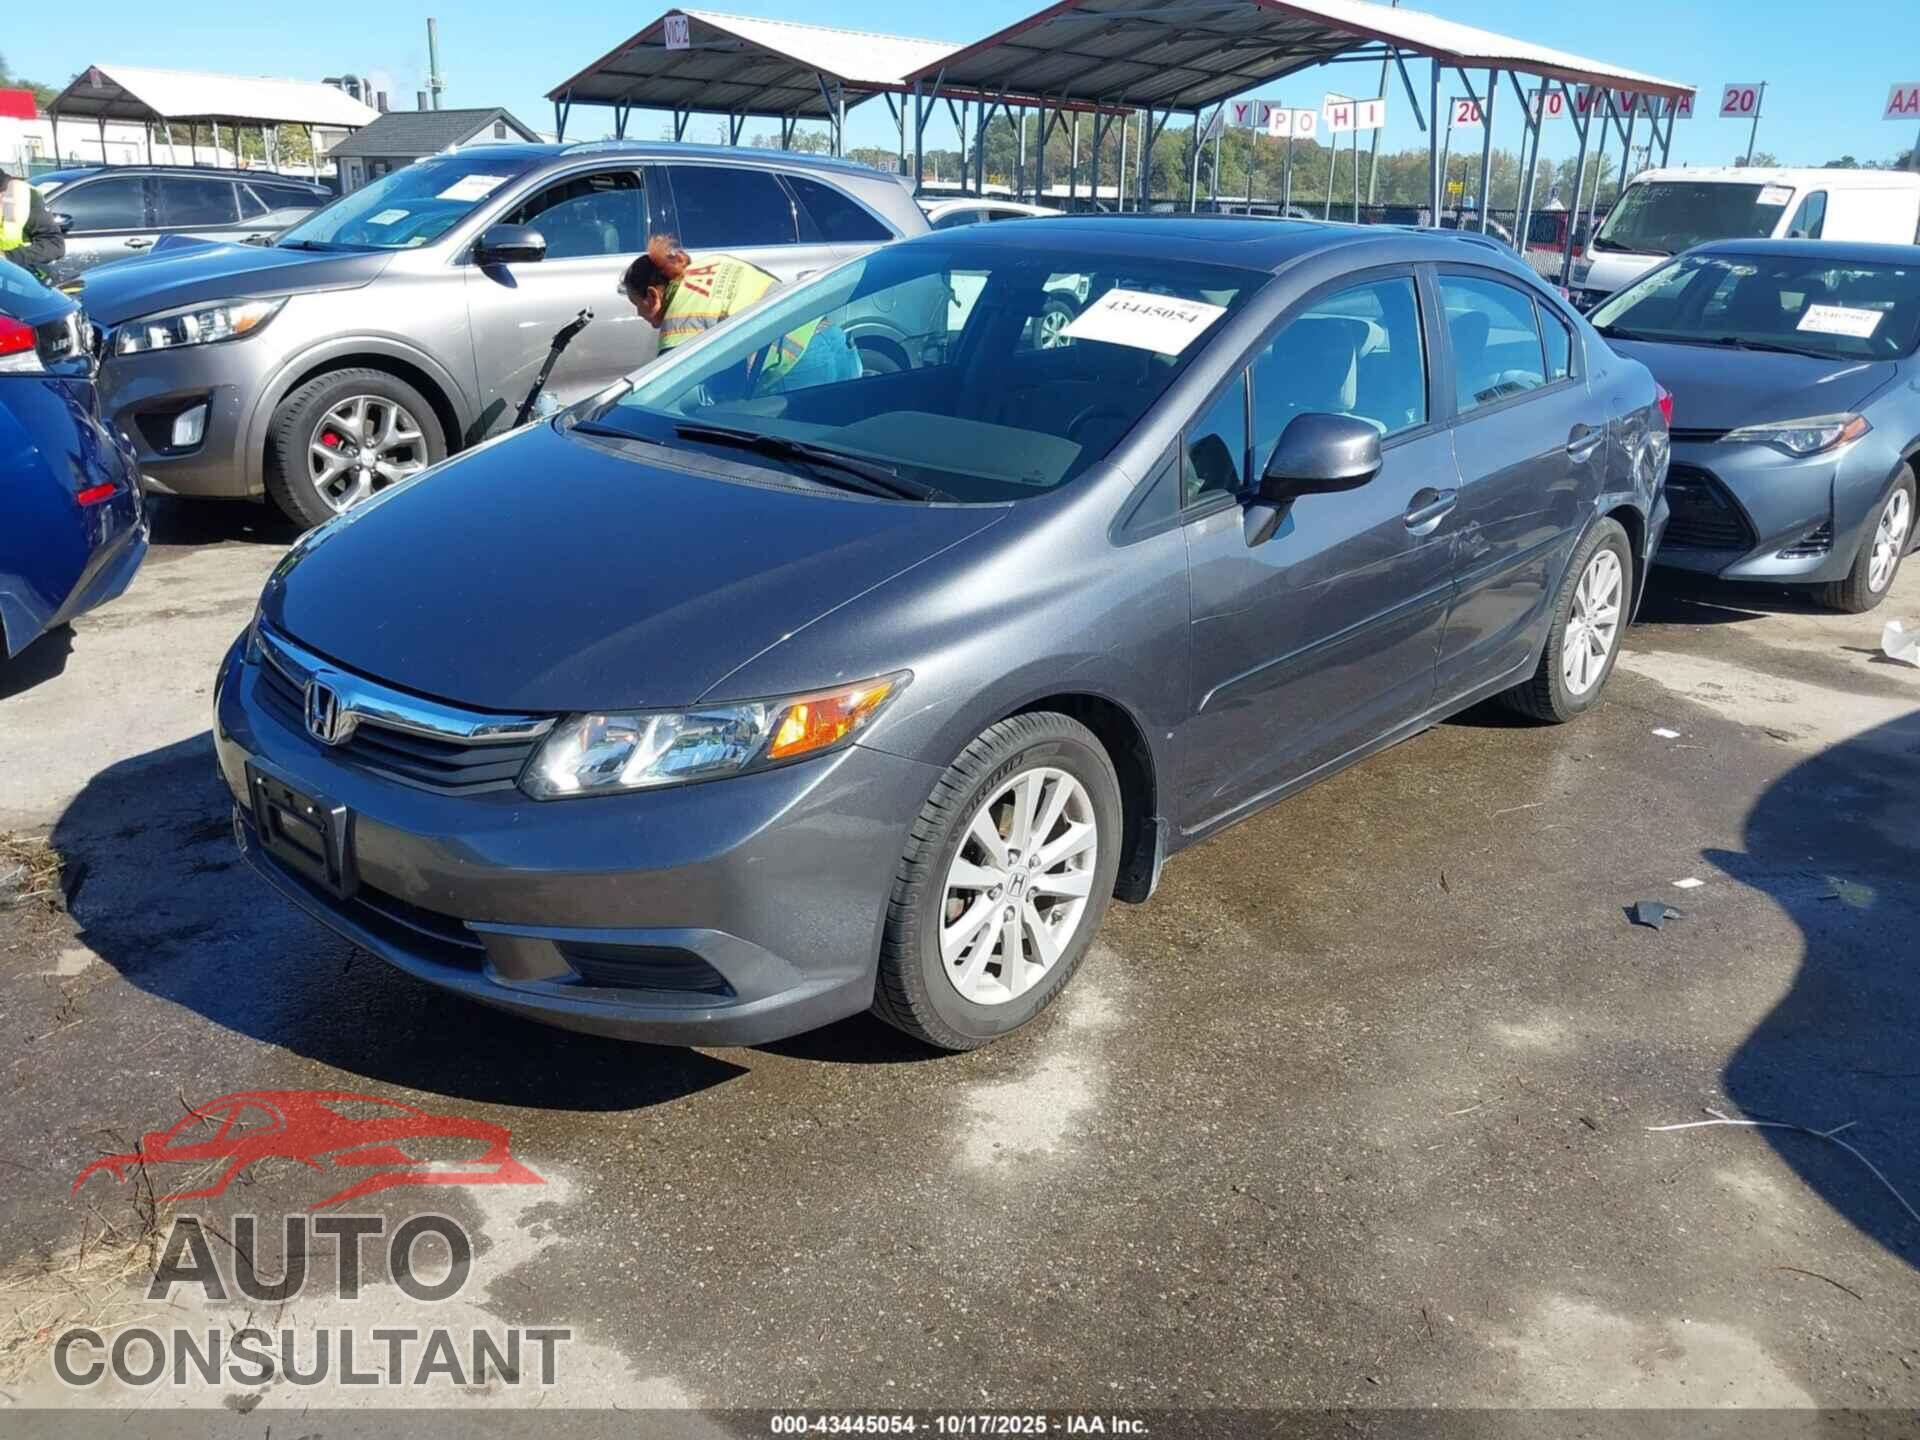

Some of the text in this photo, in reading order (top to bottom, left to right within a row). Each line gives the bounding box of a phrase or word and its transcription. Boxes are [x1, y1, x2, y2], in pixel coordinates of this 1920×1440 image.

[1723, 89, 1755, 113] 20
[1235, 104, 1248, 123] Y
[1275, 112, 1287, 131] P
[1334, 107, 1348, 127] H
[1105, 300, 1199, 323] 43445054
